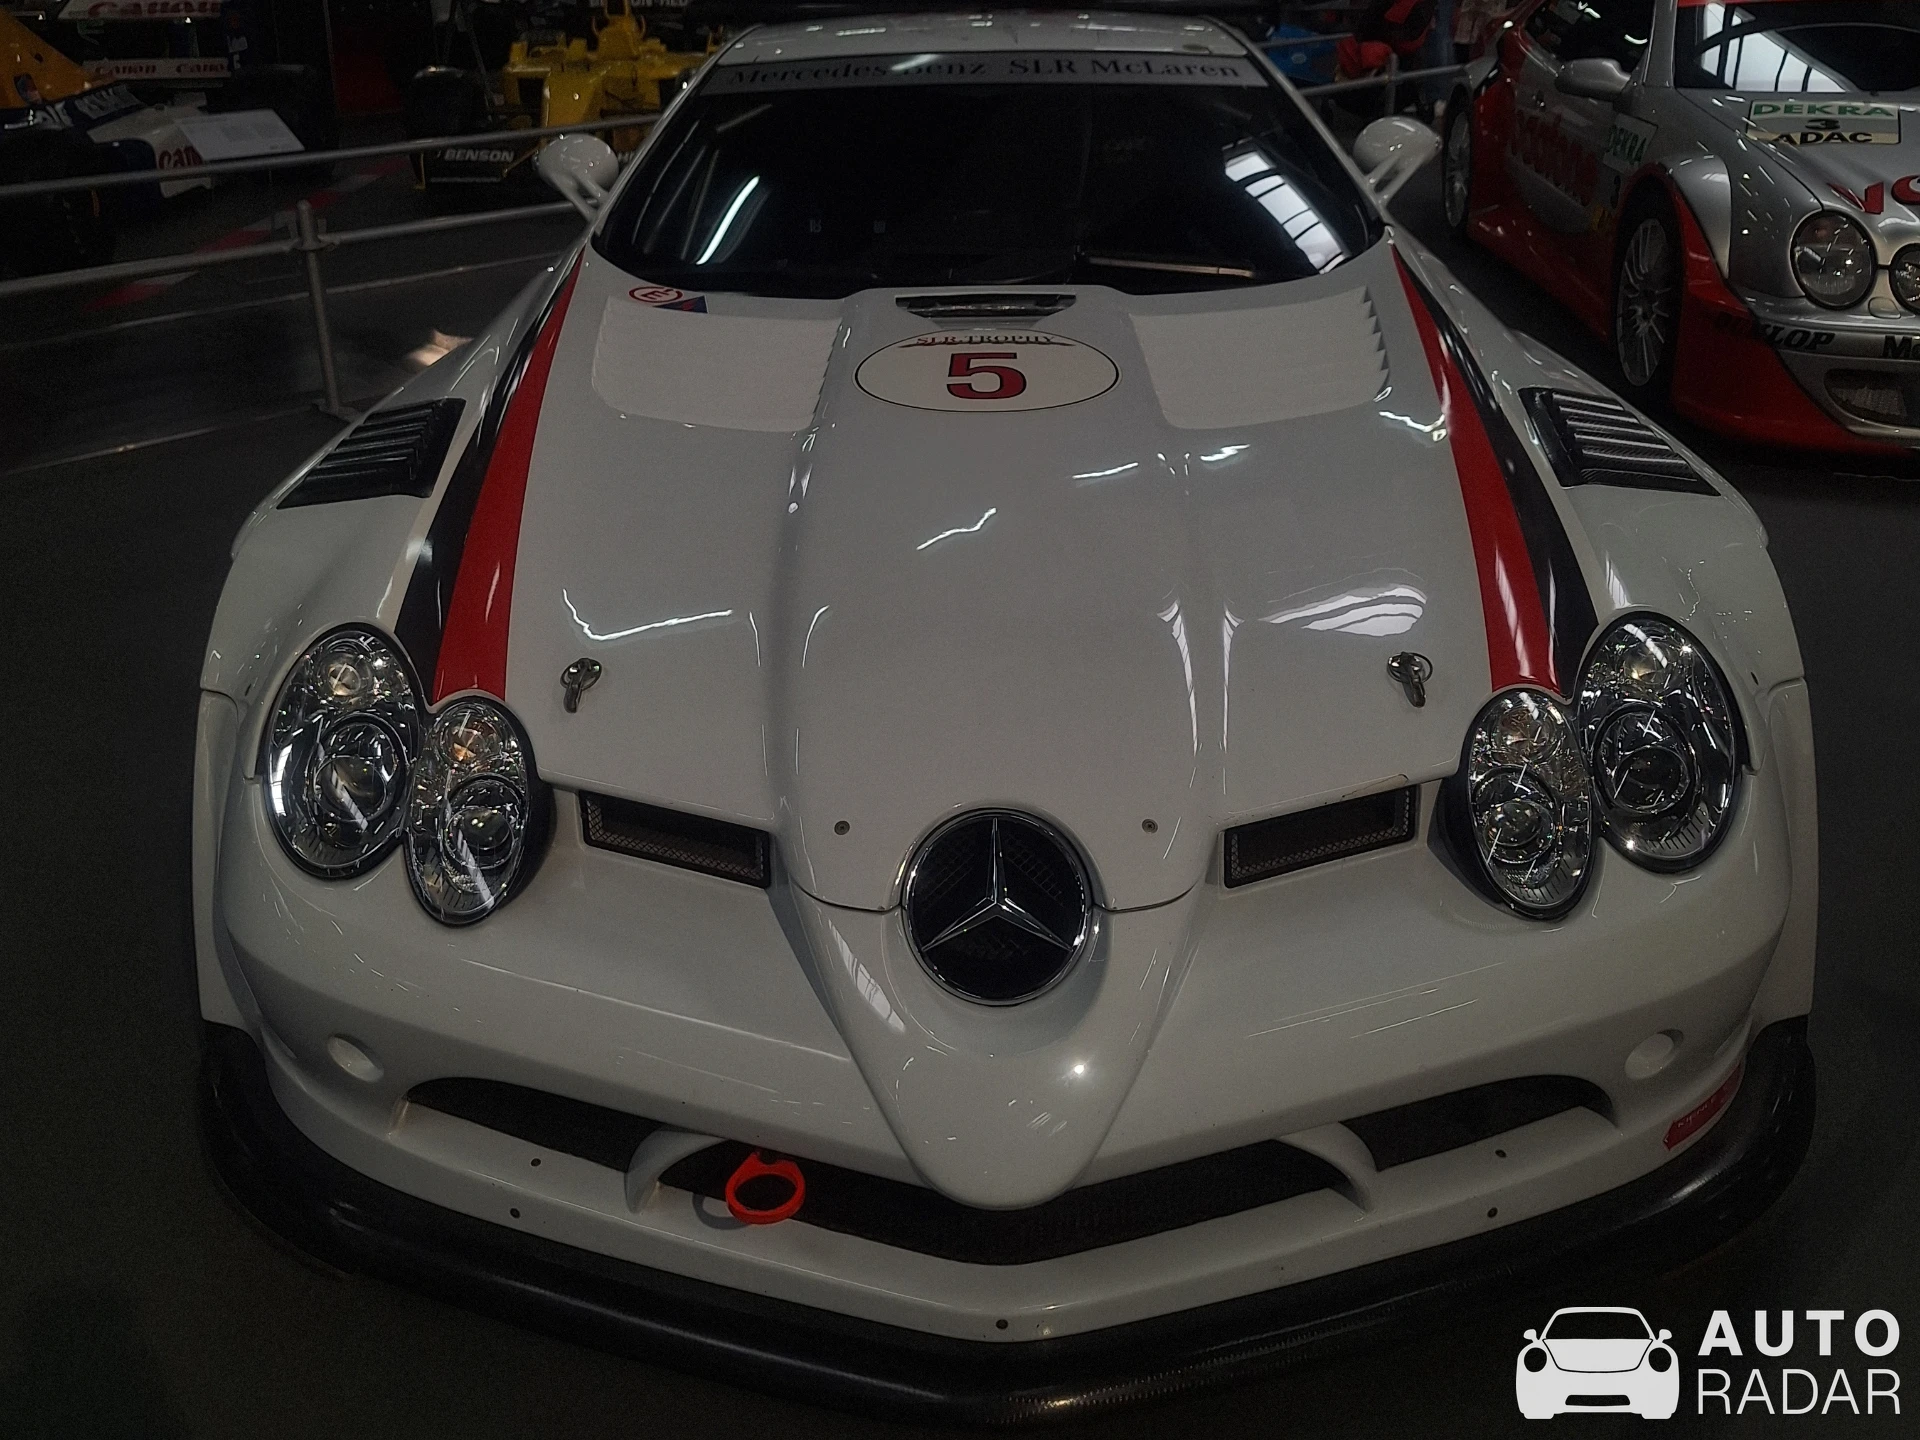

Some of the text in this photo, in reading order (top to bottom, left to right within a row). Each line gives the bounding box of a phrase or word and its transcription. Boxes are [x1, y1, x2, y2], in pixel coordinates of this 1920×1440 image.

[1009, 60, 1077, 74] SLR
[1092, 60, 1241, 78] McLaren
[1753, 104, 1894, 116] DEKRA
[1805, 118, 1841, 130] 3
[1772, 132, 1873, 145] ADAC
[444, 148, 515, 163] BENSON
[947, 353, 1027, 400] 5
